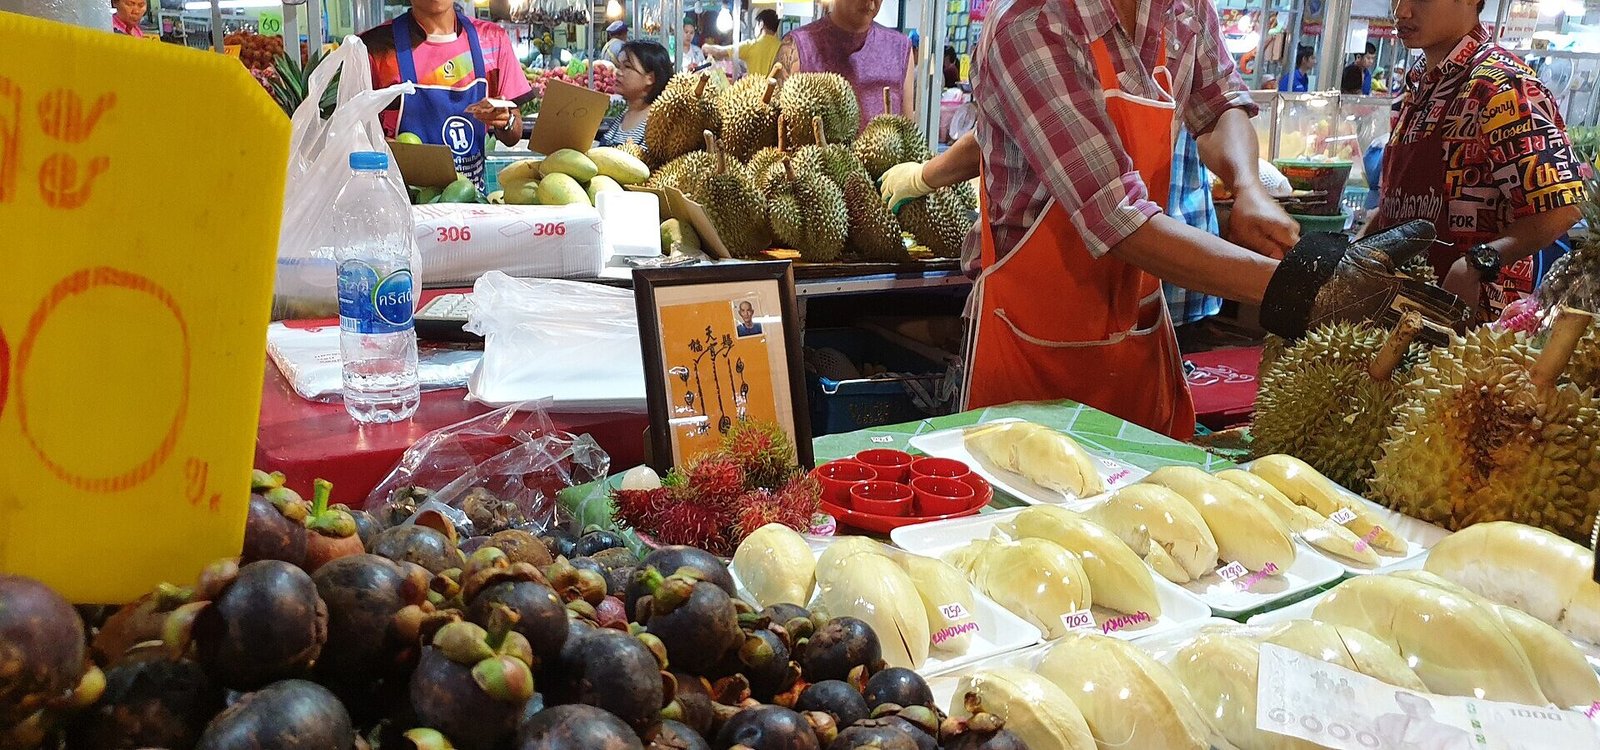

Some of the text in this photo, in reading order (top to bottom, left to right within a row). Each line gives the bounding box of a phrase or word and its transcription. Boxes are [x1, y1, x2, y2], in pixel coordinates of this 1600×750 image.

[262, 18, 280, 32] 60
[1481, 100, 1516, 125] Sorry
[1490, 119, 1531, 145] Closed
[1547, 129, 1573, 181] NEVER
[1519, 154, 1560, 191] 7th
[437, 221, 566, 242] 306 306
[1449, 214, 1474, 228] FOR
[1066, 614, 1088, 628] 200
